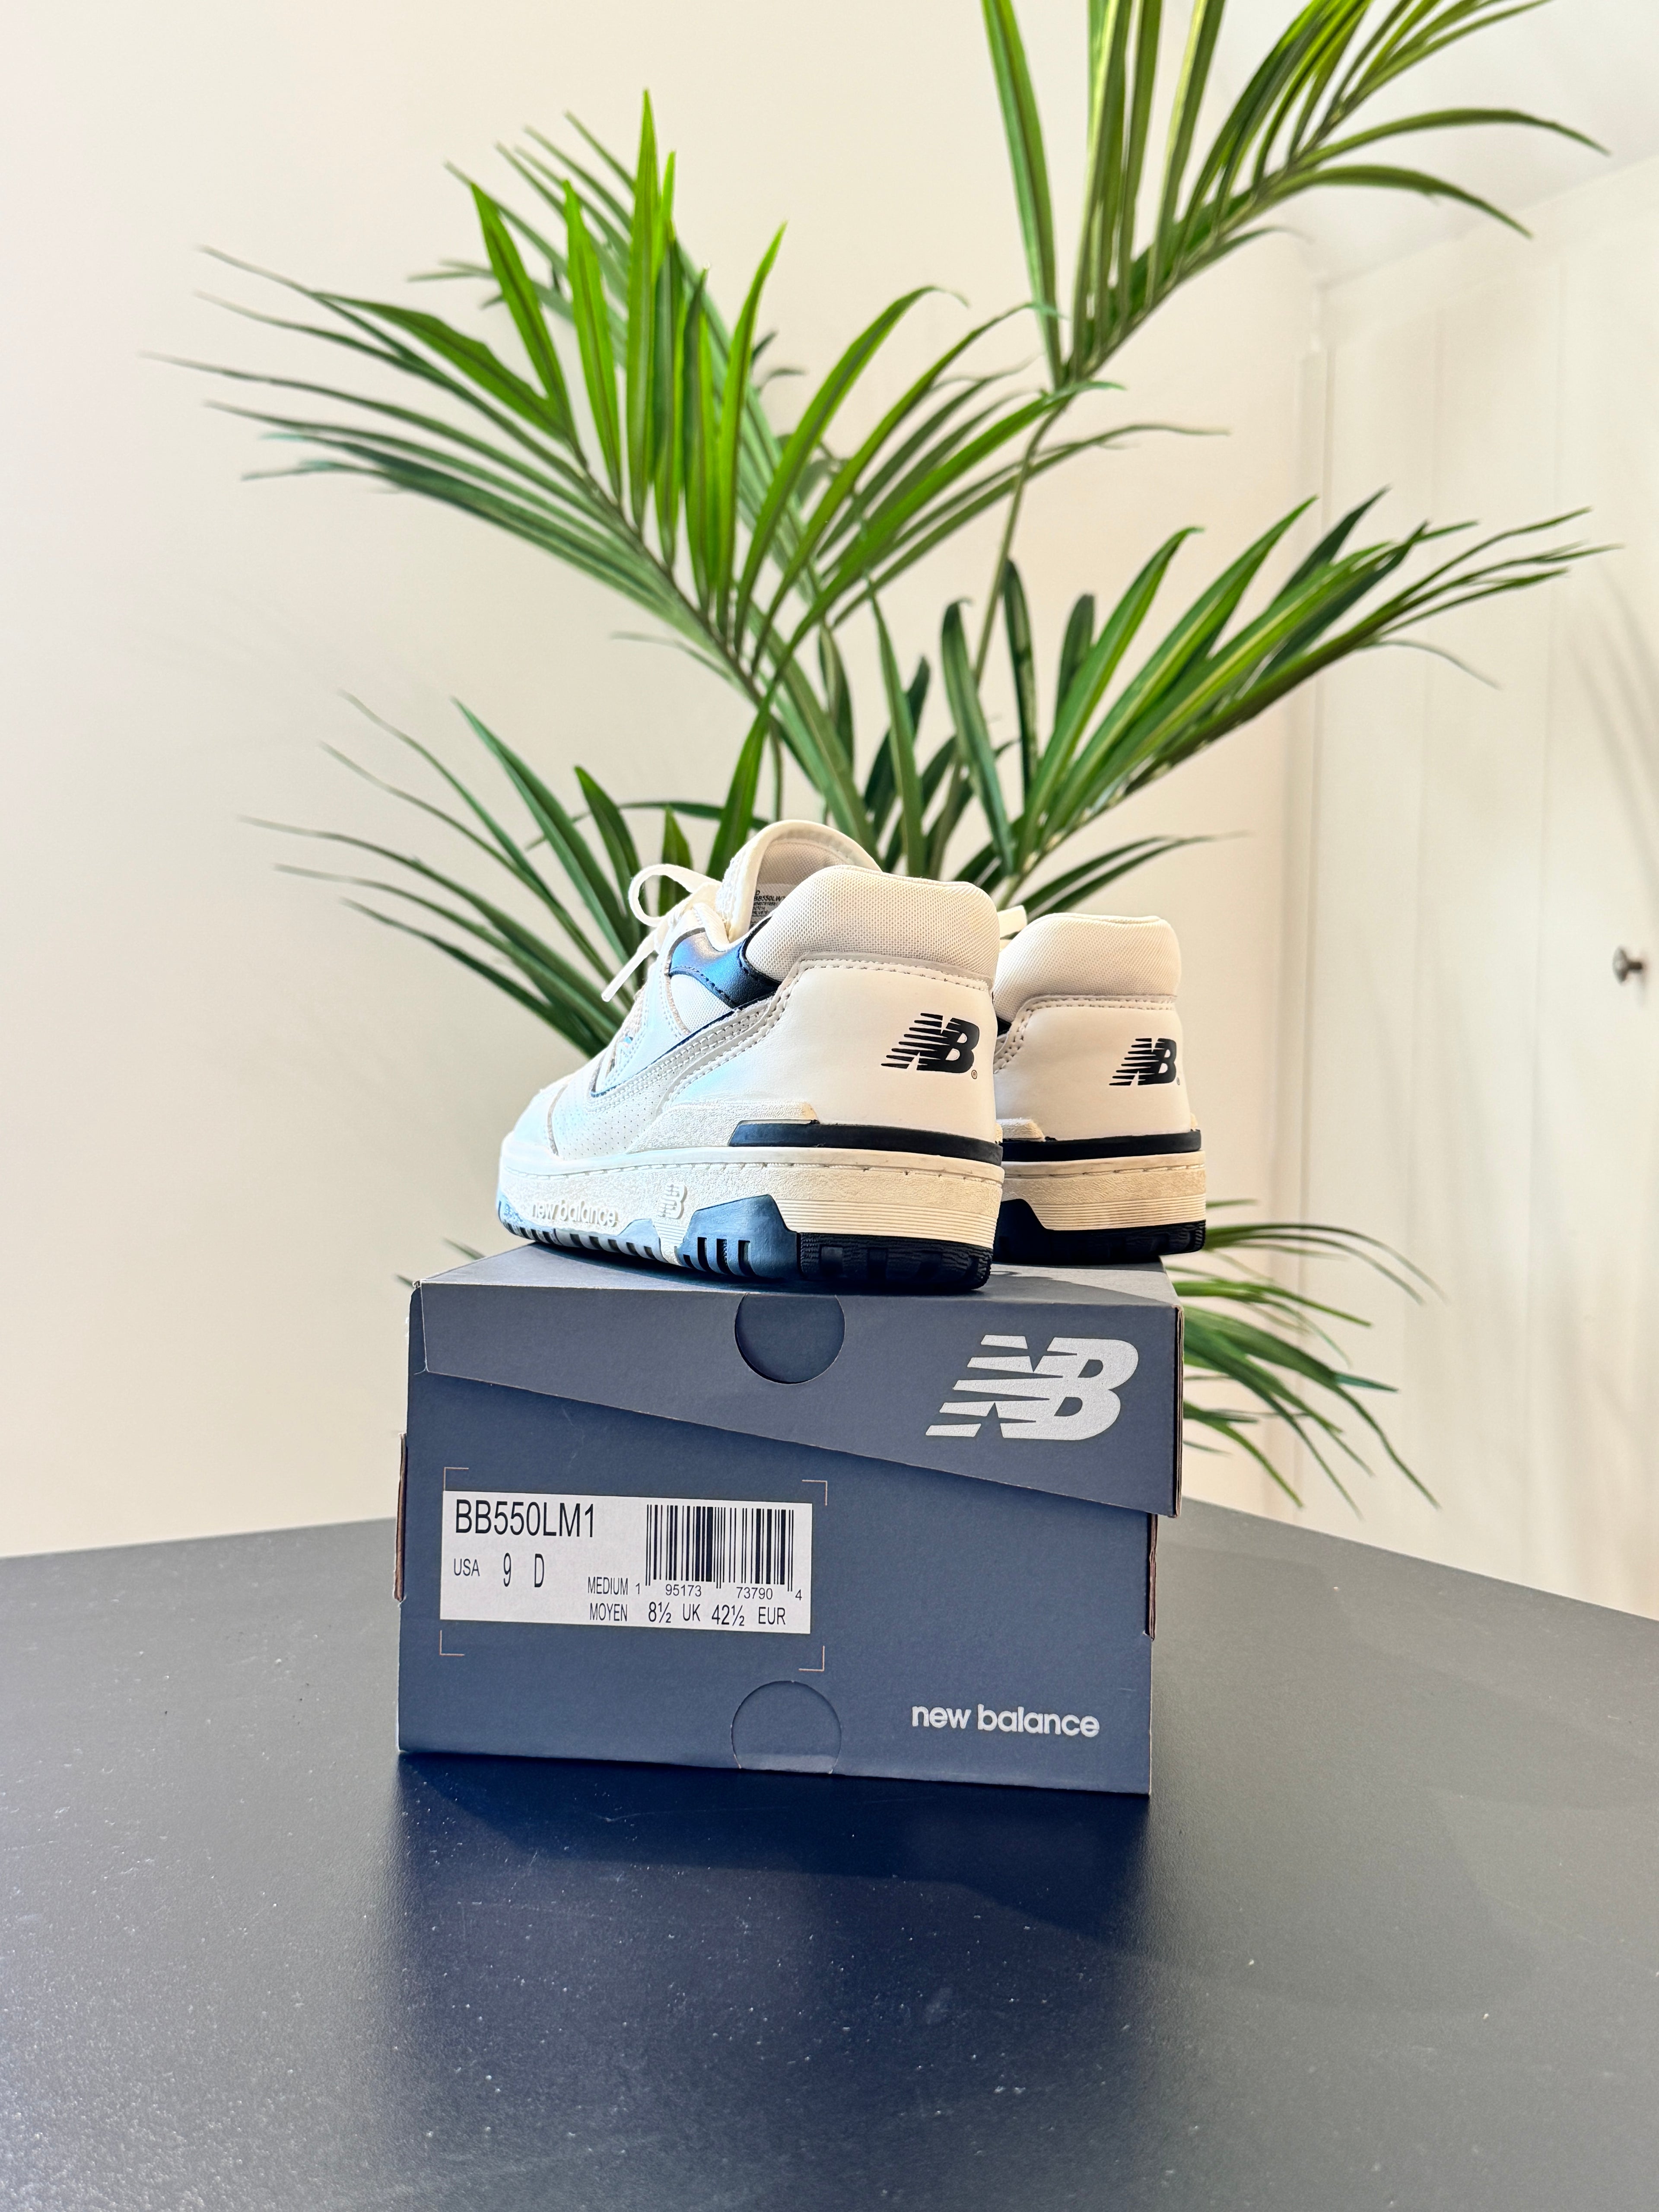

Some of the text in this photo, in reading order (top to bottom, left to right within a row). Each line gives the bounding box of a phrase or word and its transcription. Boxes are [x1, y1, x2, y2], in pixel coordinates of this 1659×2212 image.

[532, 1200, 619, 1227] new balance
[925, 1335, 1139, 1441] NB
[455, 1499, 595, 1538] BB550LM1
[454, 1552, 545, 1588] USA 9 D
[588, 1576, 629, 1596] MEDIUM
[636, 1583, 803, 1602] 1 95173 73790 4
[590, 1602, 628, 1622] MOYEN
[683, 1603, 701, 1622] UK
[758, 1607, 786, 1625] EUR
[912, 1703, 1100, 1738] new balance
